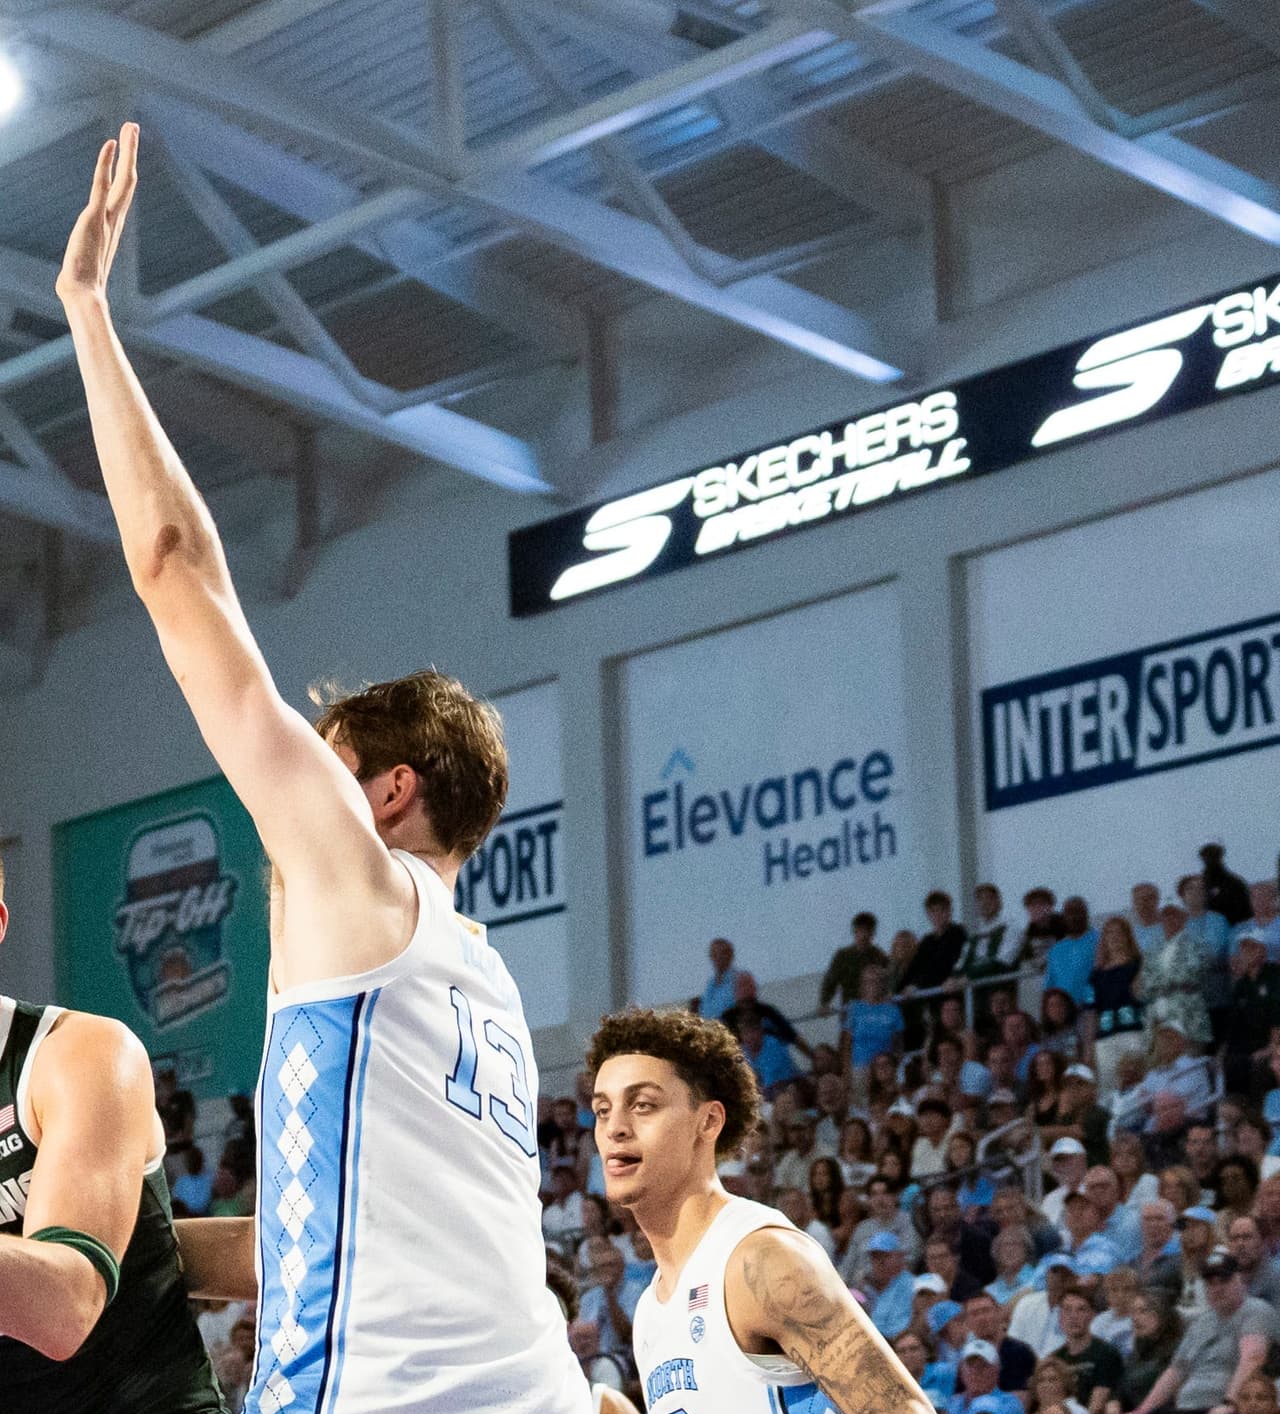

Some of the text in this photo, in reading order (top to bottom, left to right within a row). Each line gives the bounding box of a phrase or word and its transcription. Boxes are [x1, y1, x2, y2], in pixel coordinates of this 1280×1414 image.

[691, 391, 959, 518] SKECHERS
[1146, 632, 1280, 751] SPOR
[643, 748, 896, 858] Elevance
[763, 811, 897, 886] Health
[445, 985, 537, 1158] 13
[646, 1357, 699, 1410] NORTH
